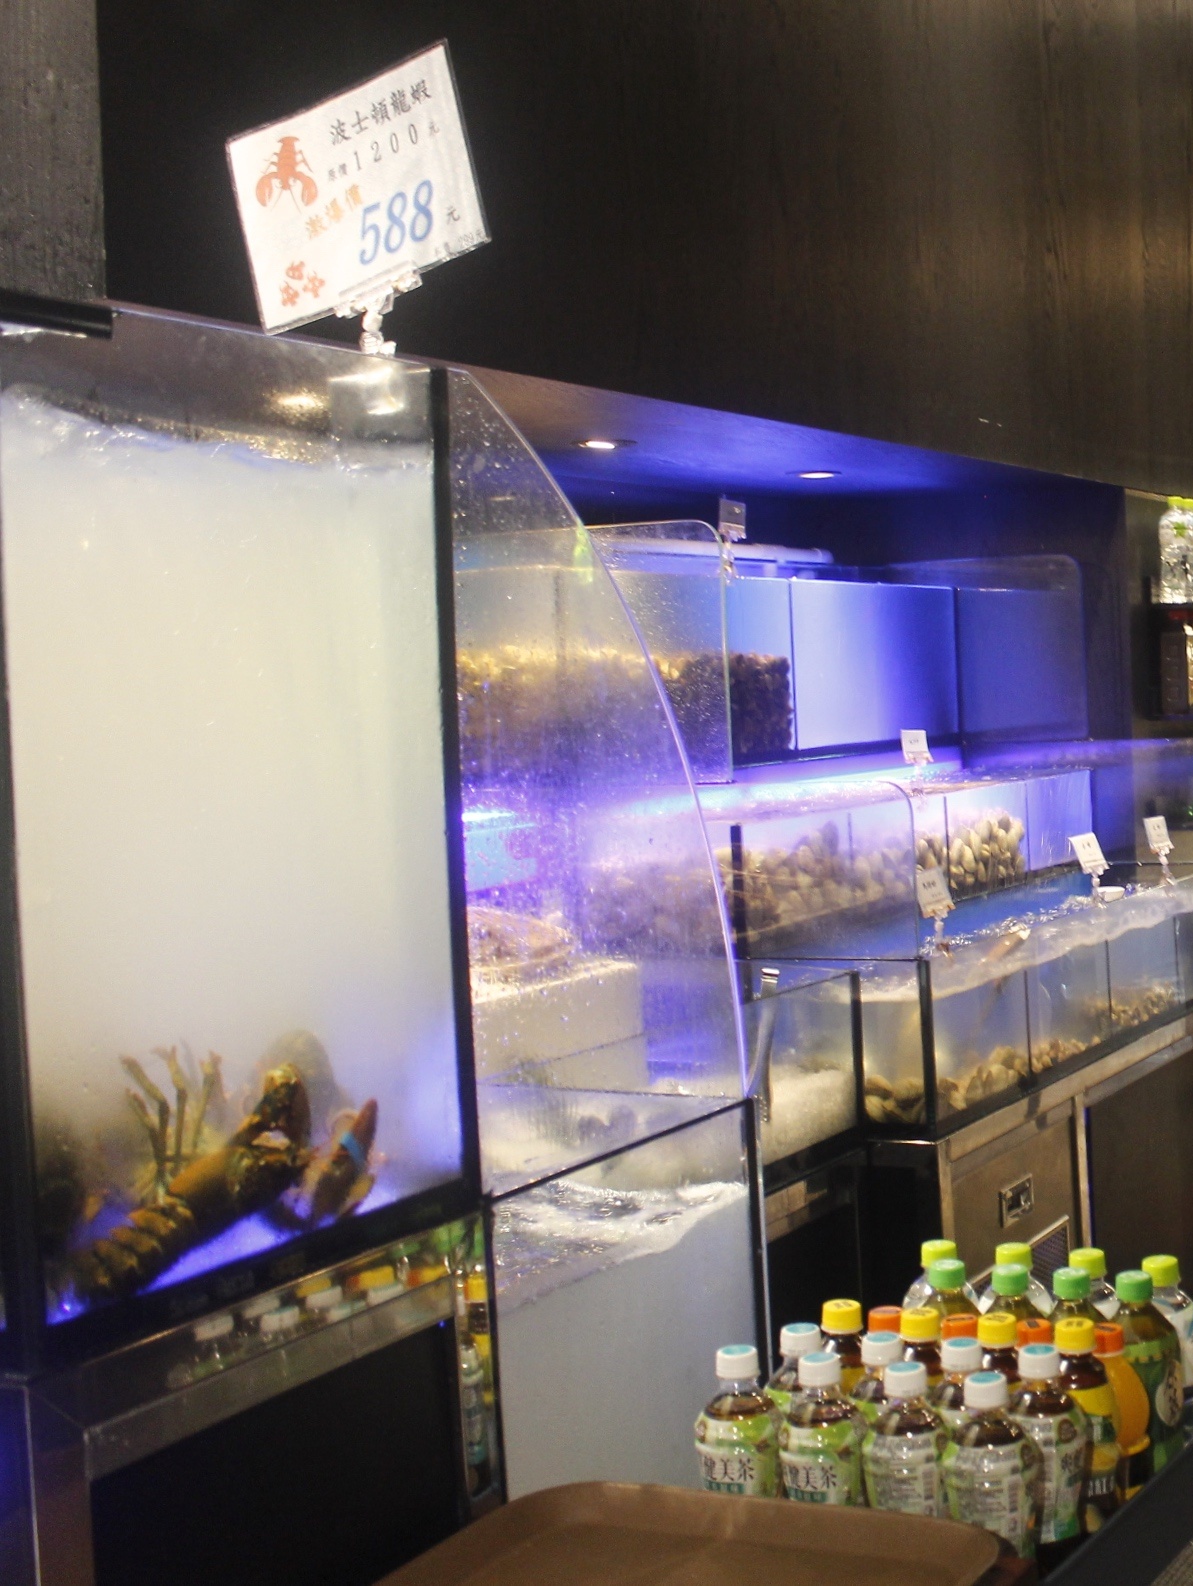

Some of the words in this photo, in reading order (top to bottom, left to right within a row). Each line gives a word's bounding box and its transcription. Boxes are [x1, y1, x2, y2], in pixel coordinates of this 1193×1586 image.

[329, 79, 432, 146] 波士頓龍蝦
[354, 123, 419, 172] 1200
[359, 179, 434, 266] 588
[446, 204, 461, 226] 元
